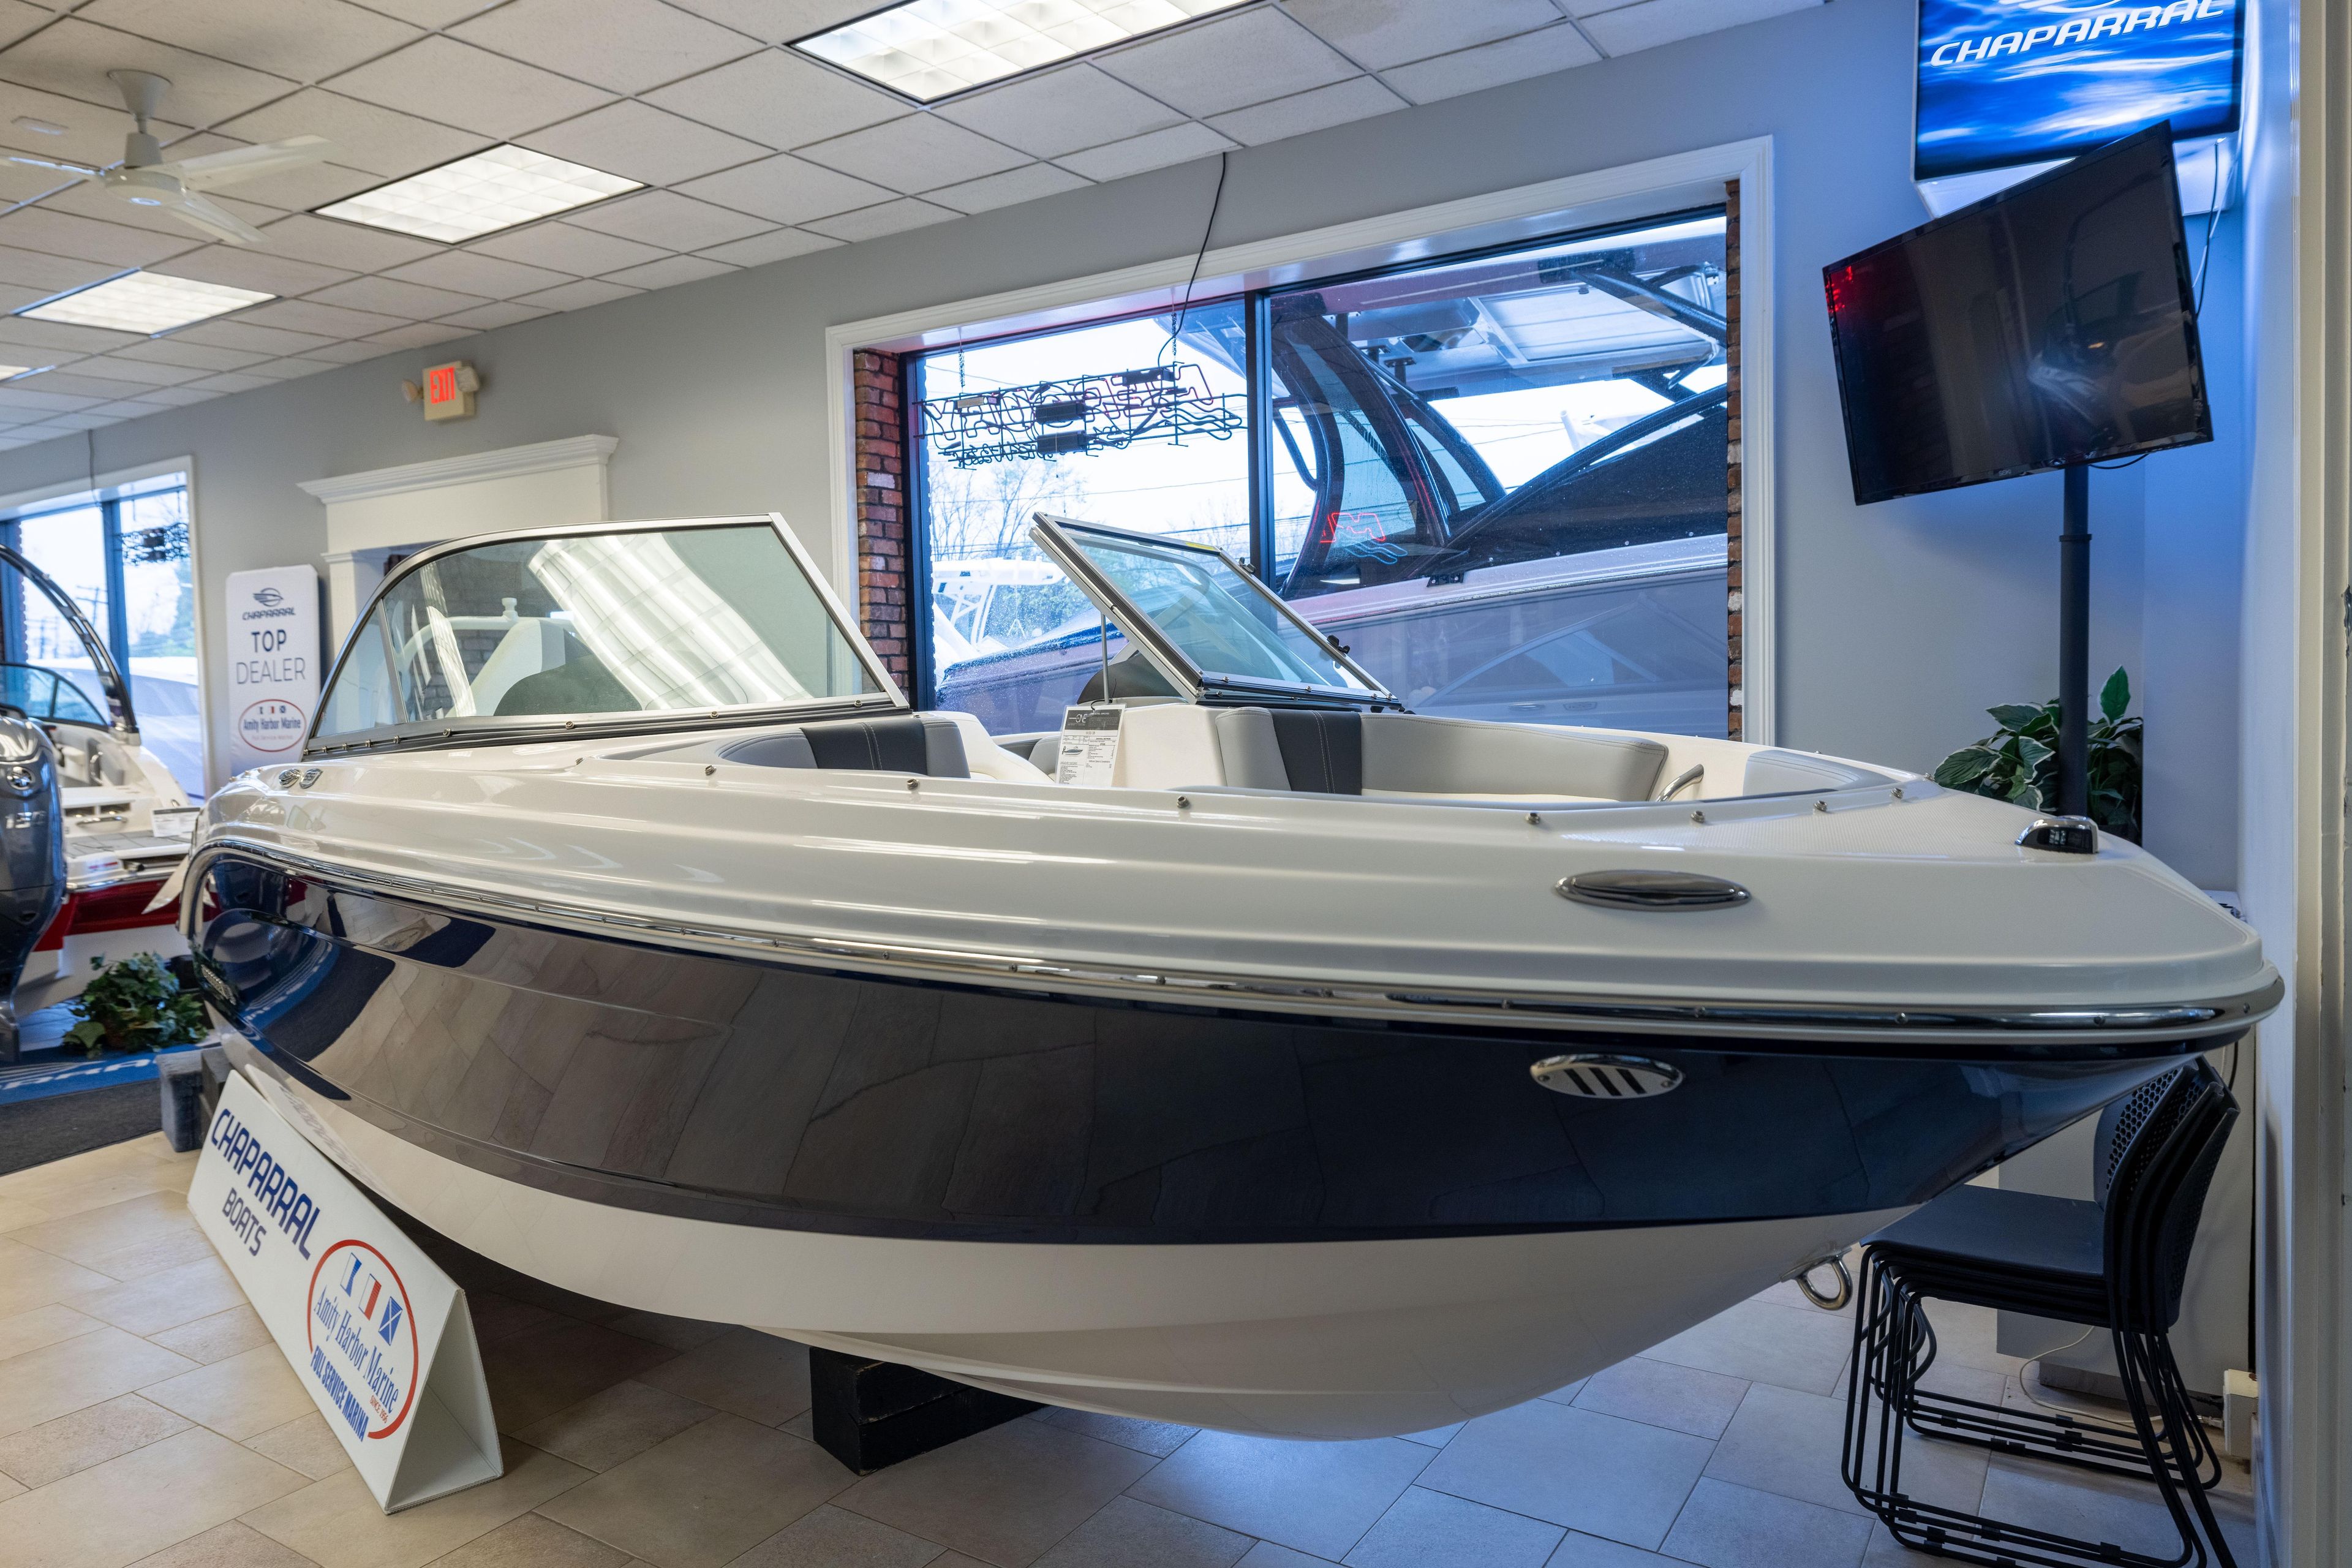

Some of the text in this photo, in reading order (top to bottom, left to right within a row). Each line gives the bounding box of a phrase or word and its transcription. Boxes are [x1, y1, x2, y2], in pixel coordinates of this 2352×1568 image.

[1931, 0, 2225, 67] CHAPARRAL
[430, 366, 456, 404] EXIT
[242, 607, 296, 620] CHAPARRAL
[251, 629, 287, 652] TOP
[236, 657, 306, 684] DEALER
[244, 717, 301, 733] Amity Harbor Marine
[1076, 714, 1087, 723] ONE
[211, 1109, 320, 1261] CHAPARRAL
[222, 1187, 266, 1256] BOATS
[314, 1284, 399, 1414] Amity Harbor Marine
[311, 1345, 369, 1442] FULL SERVICE MARINA
[369, 1395, 380, 1414] SINCE
